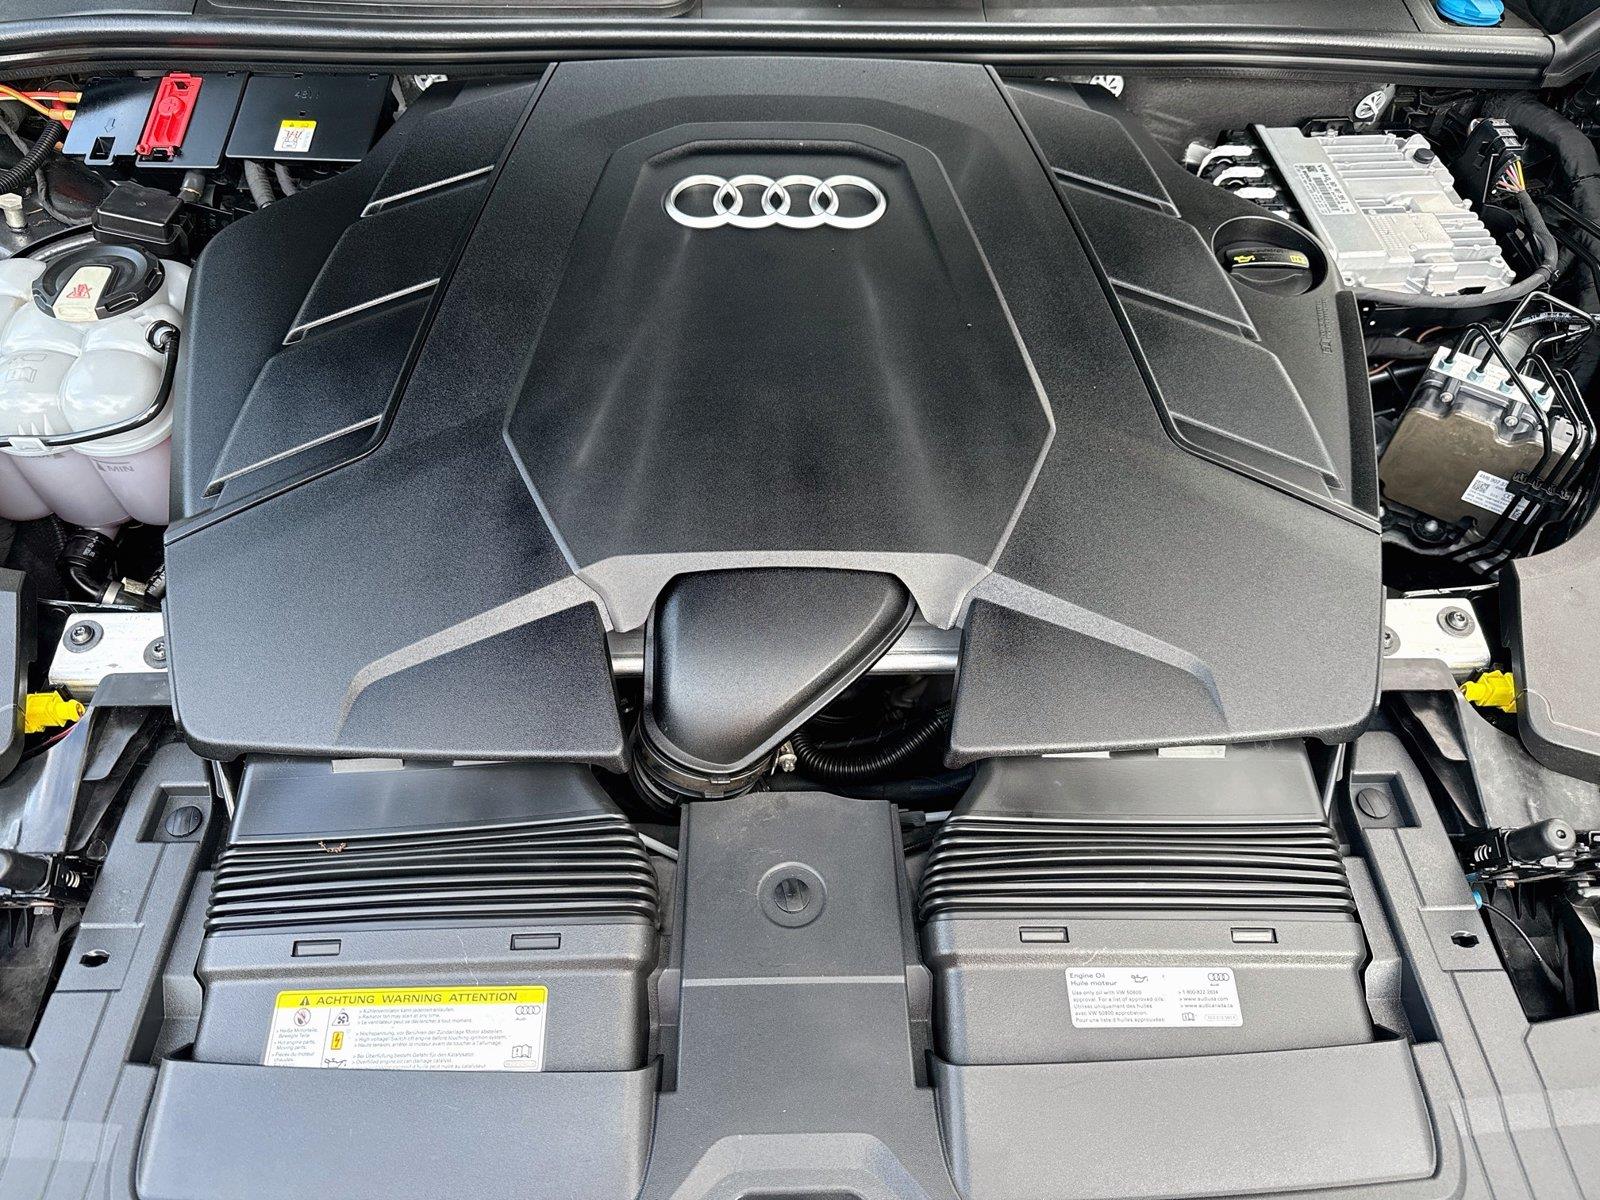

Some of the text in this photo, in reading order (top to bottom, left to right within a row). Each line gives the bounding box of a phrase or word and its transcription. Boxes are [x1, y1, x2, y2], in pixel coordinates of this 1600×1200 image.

[316, 992, 518, 1006] ACHTUNG WARNING ATTENTION
